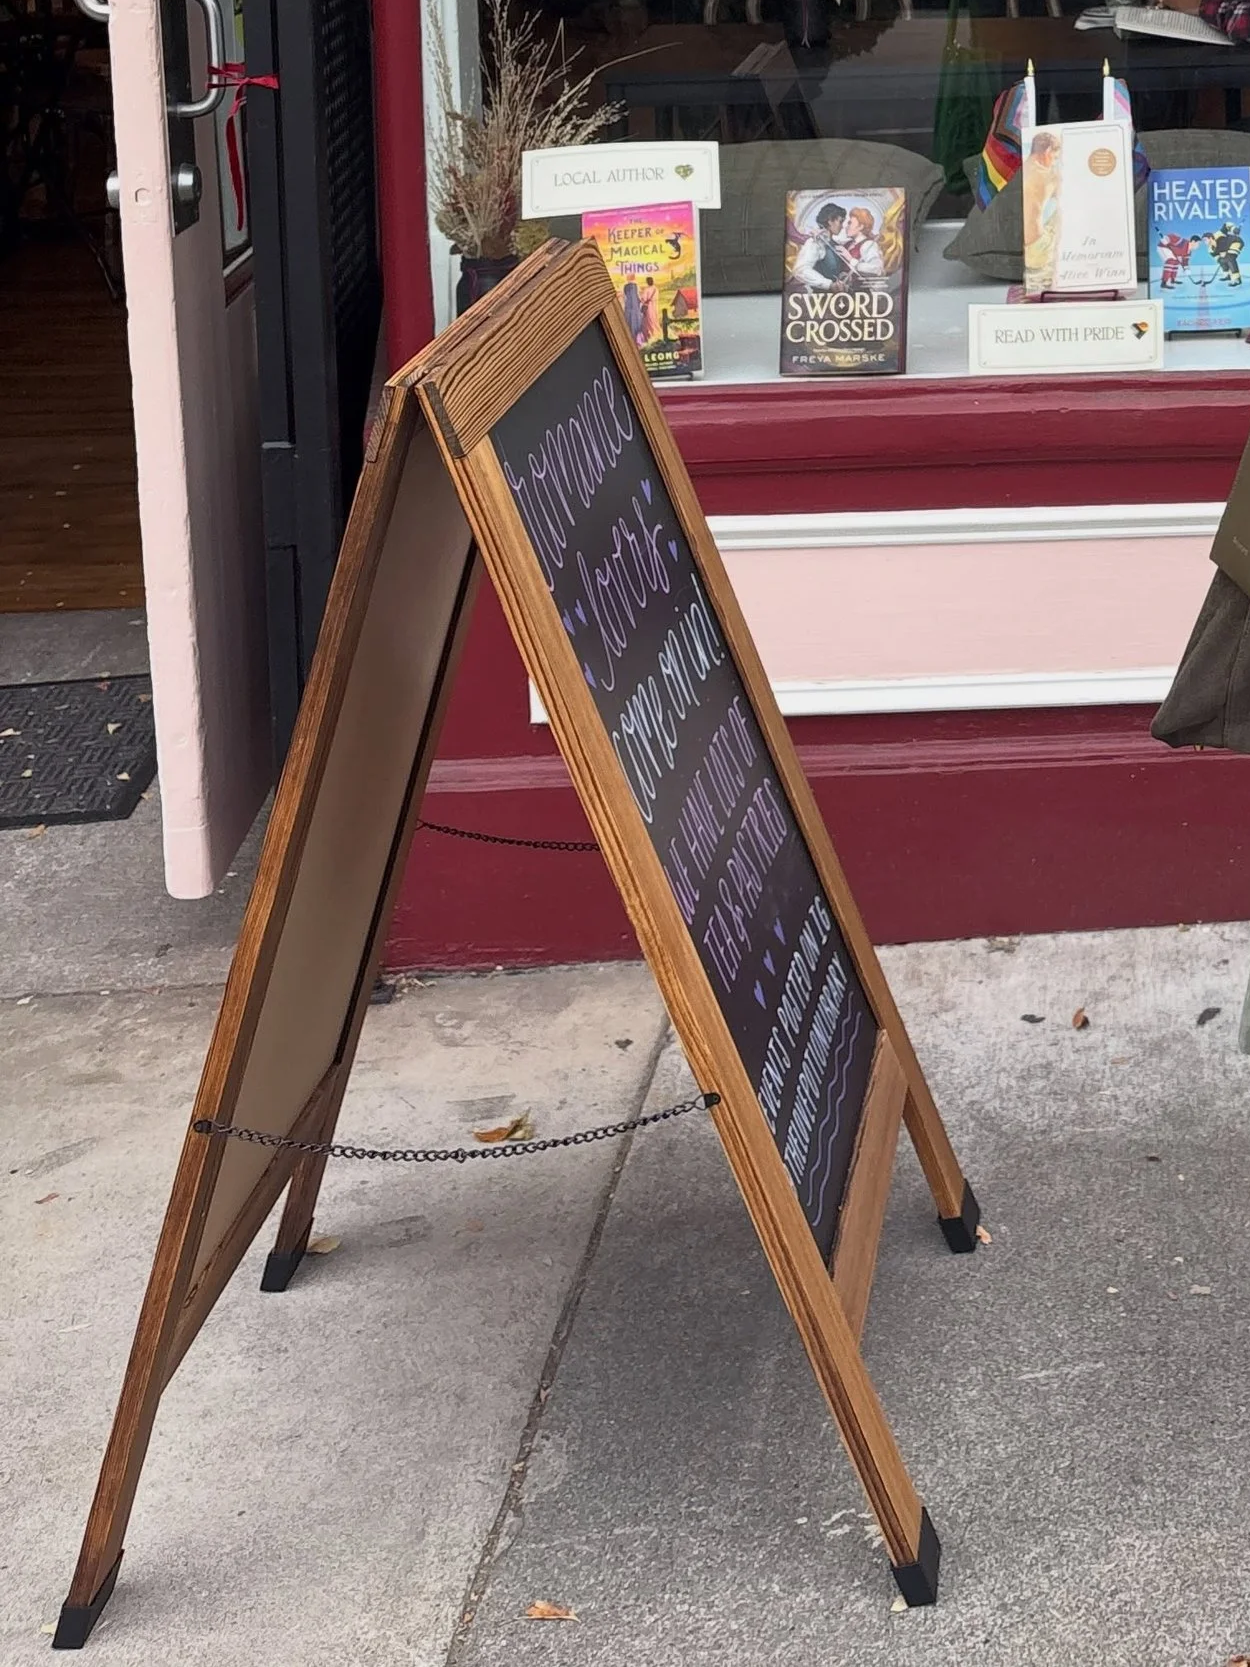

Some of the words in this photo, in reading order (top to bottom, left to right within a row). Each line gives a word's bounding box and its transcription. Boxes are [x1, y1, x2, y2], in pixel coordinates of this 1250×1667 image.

[553, 171, 602, 188] LOCAL
[606, 166, 665, 184] AUTHOR
[1152, 179, 1249, 201] HEATED
[1154, 199, 1248, 222] RIVALRY
[606, 243, 666, 262] MAGICAL
[607, 226, 652, 244] KEEPER
[615, 260, 660, 276] THINGS
[785, 318, 895, 346] CROSSED
[787, 291, 894, 321] SWORD
[994, 328, 1036, 344] READ
[1039, 327, 1080, 343] WITH
[1083, 326, 1126, 342] PRIDE
[644, 351, 680, 363] LEONG
[791, 354, 832, 364] FREYA
[834, 353, 887, 363] MARSKE
[502, 365, 634, 593] romance
[576, 495, 671, 693] lovers
[673, 572, 726, 681] in!
[658, 629, 701, 721] on
[612, 675, 679, 824] come
[727, 695, 758, 768] OF
[702, 724, 746, 819] LOTS
[677, 769, 726, 881] HAVE
[725, 777, 789, 920] PASTRIES
[663, 837, 700, 926] WE
[717, 877, 753, 953] &
[702, 904, 744, 994] TEA
[798, 919, 821, 973] ON
[807, 894, 832, 945] IG
[776, 950, 814, 1049] POSTED
[757, 1025, 792, 1135] EVENTS
